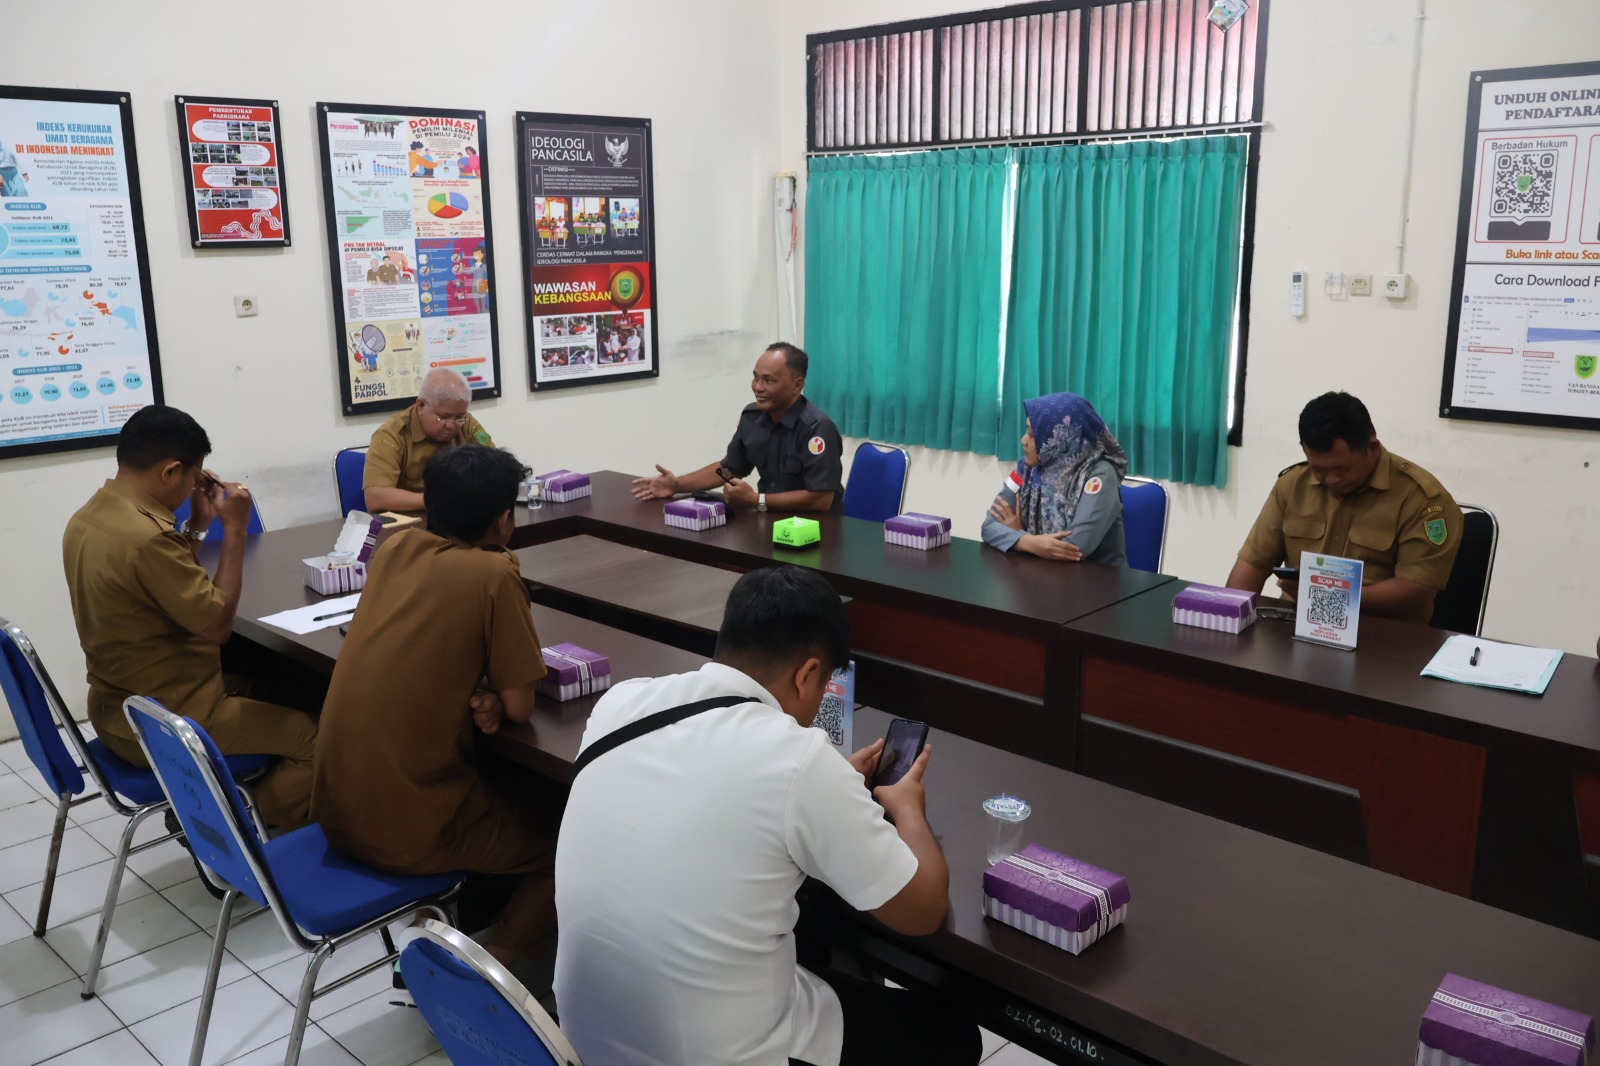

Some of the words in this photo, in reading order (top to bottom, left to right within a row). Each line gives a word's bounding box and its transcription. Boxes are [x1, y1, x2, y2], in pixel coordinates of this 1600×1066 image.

[1494, 92, 1547, 105] UNDUH
[37, 122, 65, 132] INDEKS
[68, 124, 112, 133] KERUKUNAN
[409, 118, 475, 132] DOMINASI
[443, 127, 473, 136] MILENIAL
[46, 134, 68, 143] UMAT
[71, 135, 113, 144] BERAGAMA
[532, 137, 584, 149] IDEOLOGI
[16, 144, 24, 153] DI
[27, 145, 68, 154] INDONESIA
[71, 146, 114, 155] MENINGKAT
[1492, 142, 1533, 150] Berbadan
[532, 149, 593, 161] PANCASILA
[1506, 250, 1532, 259] Buka
[1535, 250, 1552, 259] link
[1555, 251, 1578, 259] atau
[1582, 250, 1600, 259] Sca
[1494, 274, 1523, 286] Cara
[1527, 274, 1590, 287] Download
[534, 281, 596, 294] WAWASAN
[534, 291, 612, 304] KEBANGSAAN
[355, 383, 385, 392] FUNGSI
[355, 390, 388, 399] PARPOL
